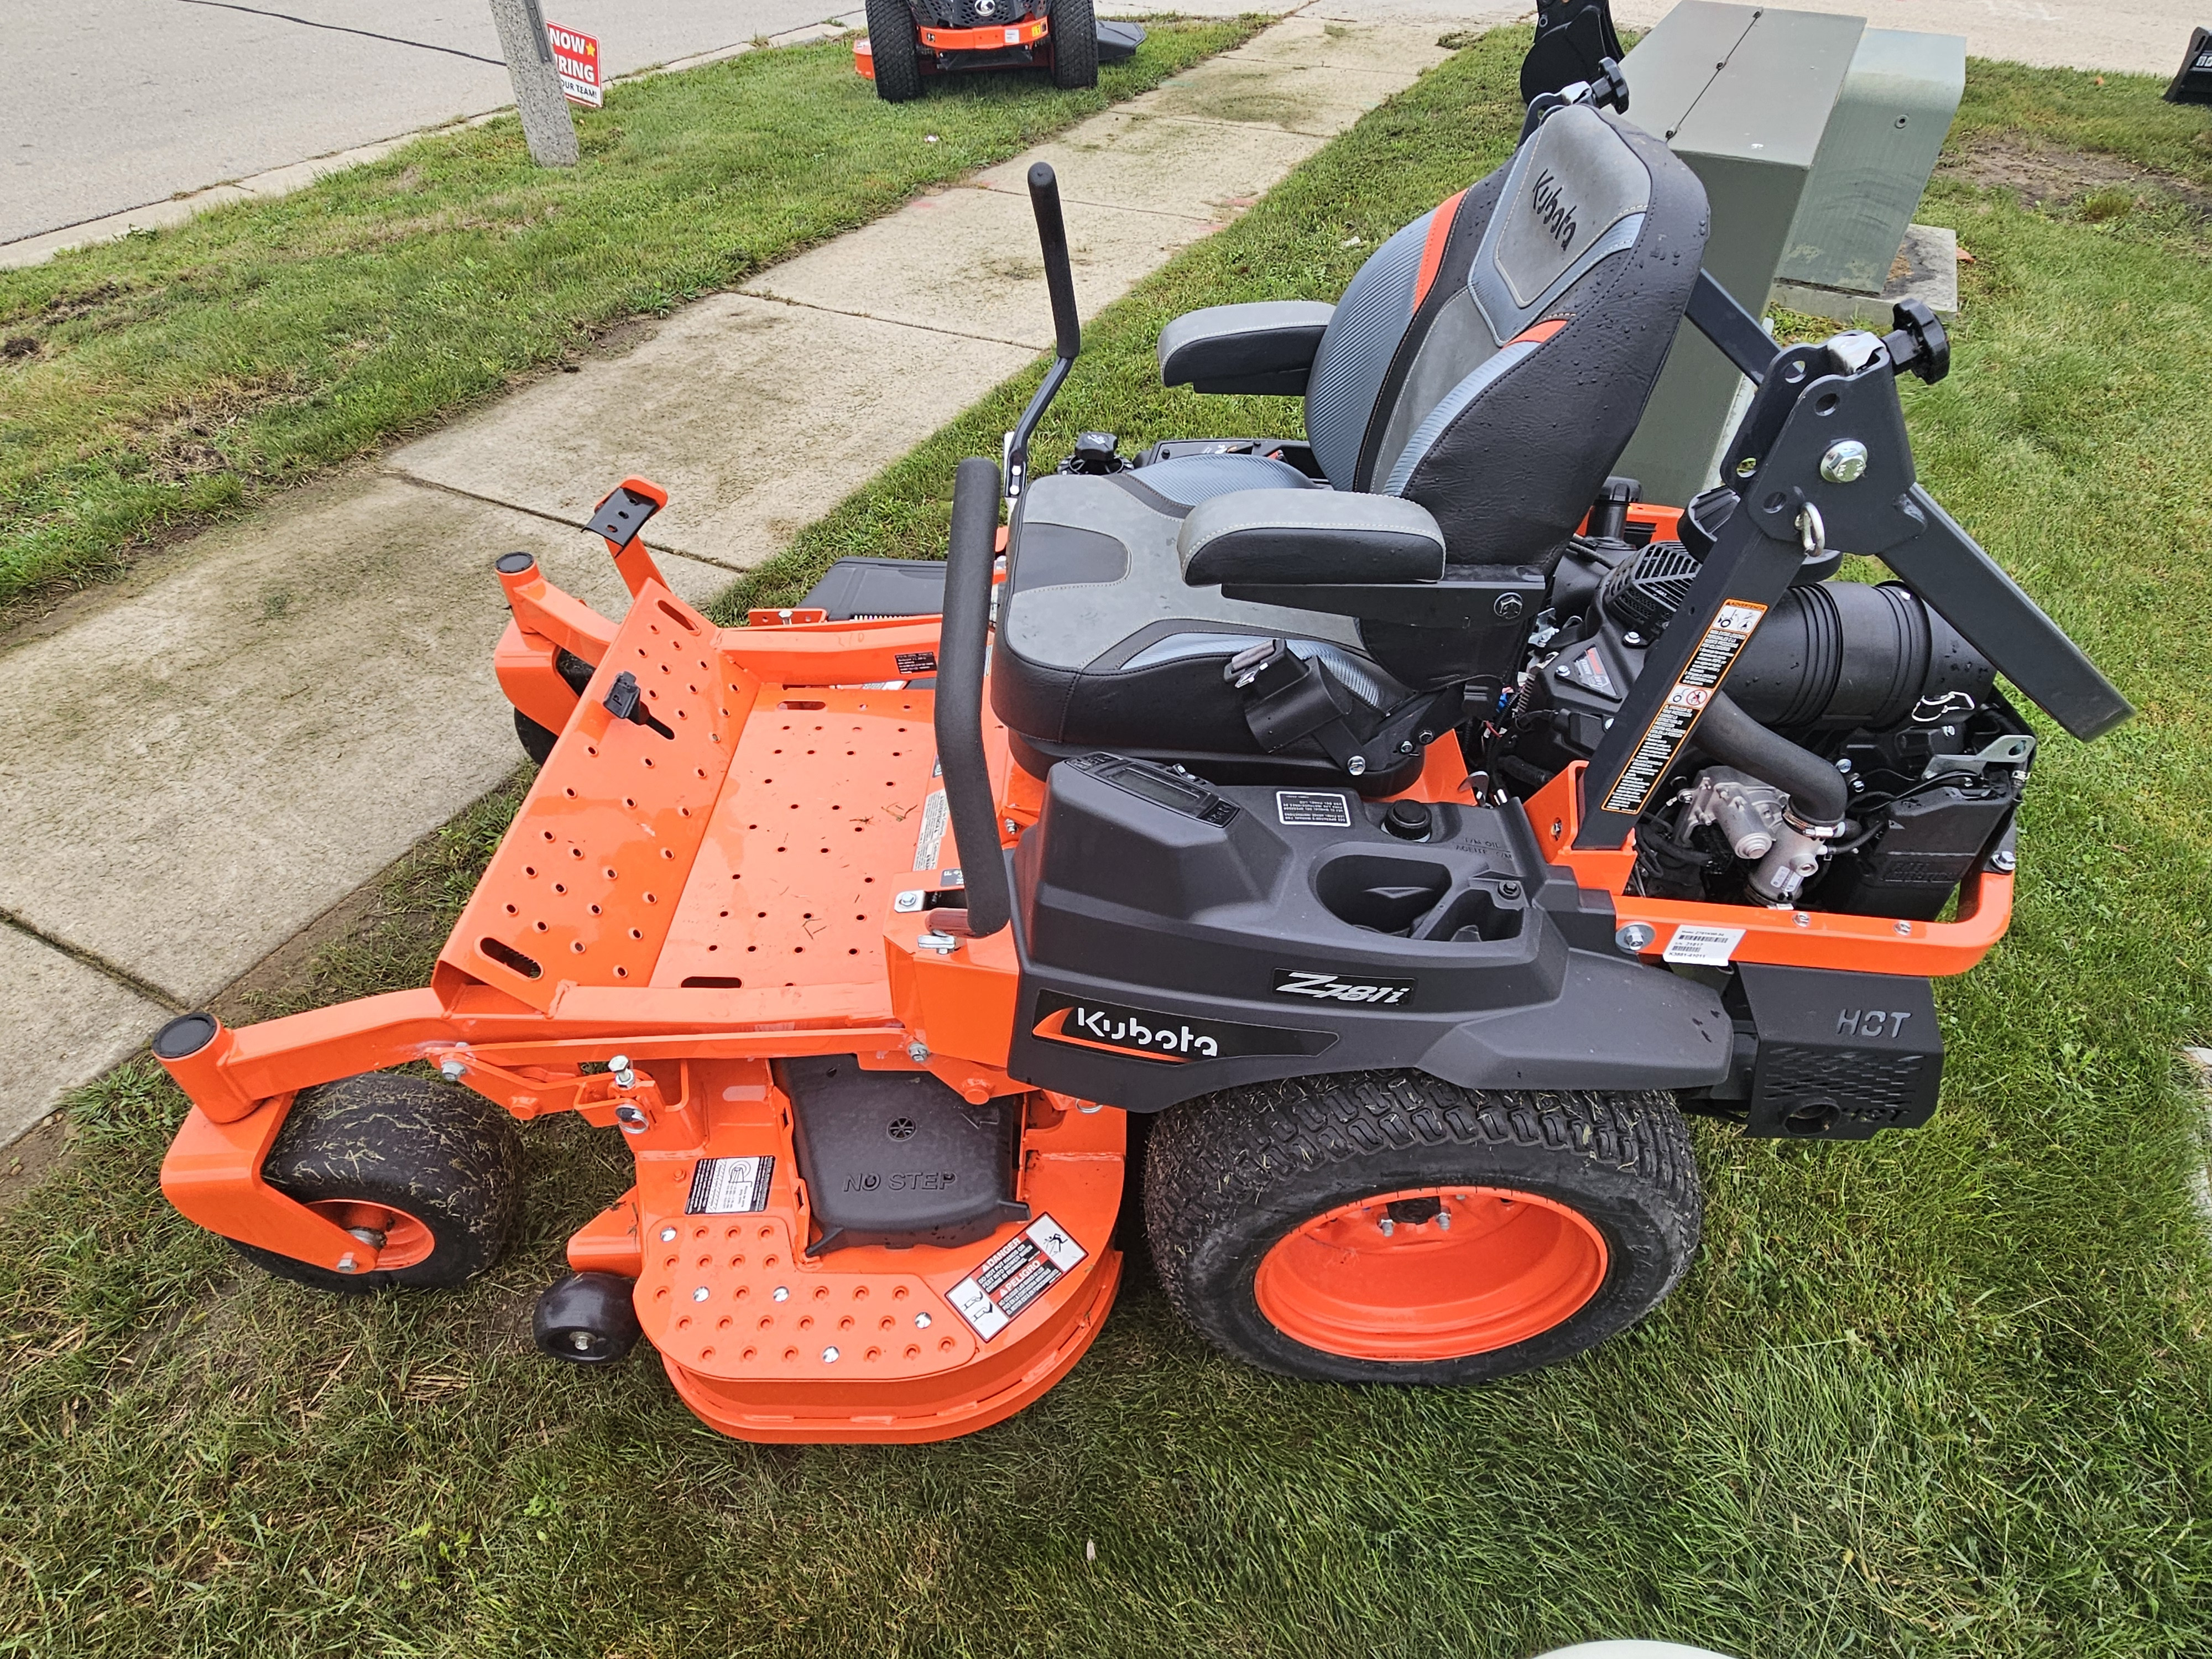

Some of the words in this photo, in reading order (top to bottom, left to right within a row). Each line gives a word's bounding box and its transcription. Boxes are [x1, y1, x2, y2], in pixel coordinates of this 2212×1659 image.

[549, 27, 585, 55] NOW
[576, 84, 597, 98] TEAM!
[1532, 168, 1577, 252] Kubota
[1276, 419, 1410, 450] Z781i
[1077, 454, 1218, 503] Kubota
[1837, 1008, 1912, 1038] HOT
[843, 1173, 880, 1192] NO
[889, 1171, 957, 1191] STEP
[987, 1238, 1021, 1265] DANGER
[1005, 1260, 1041, 1289] PELIGRO
